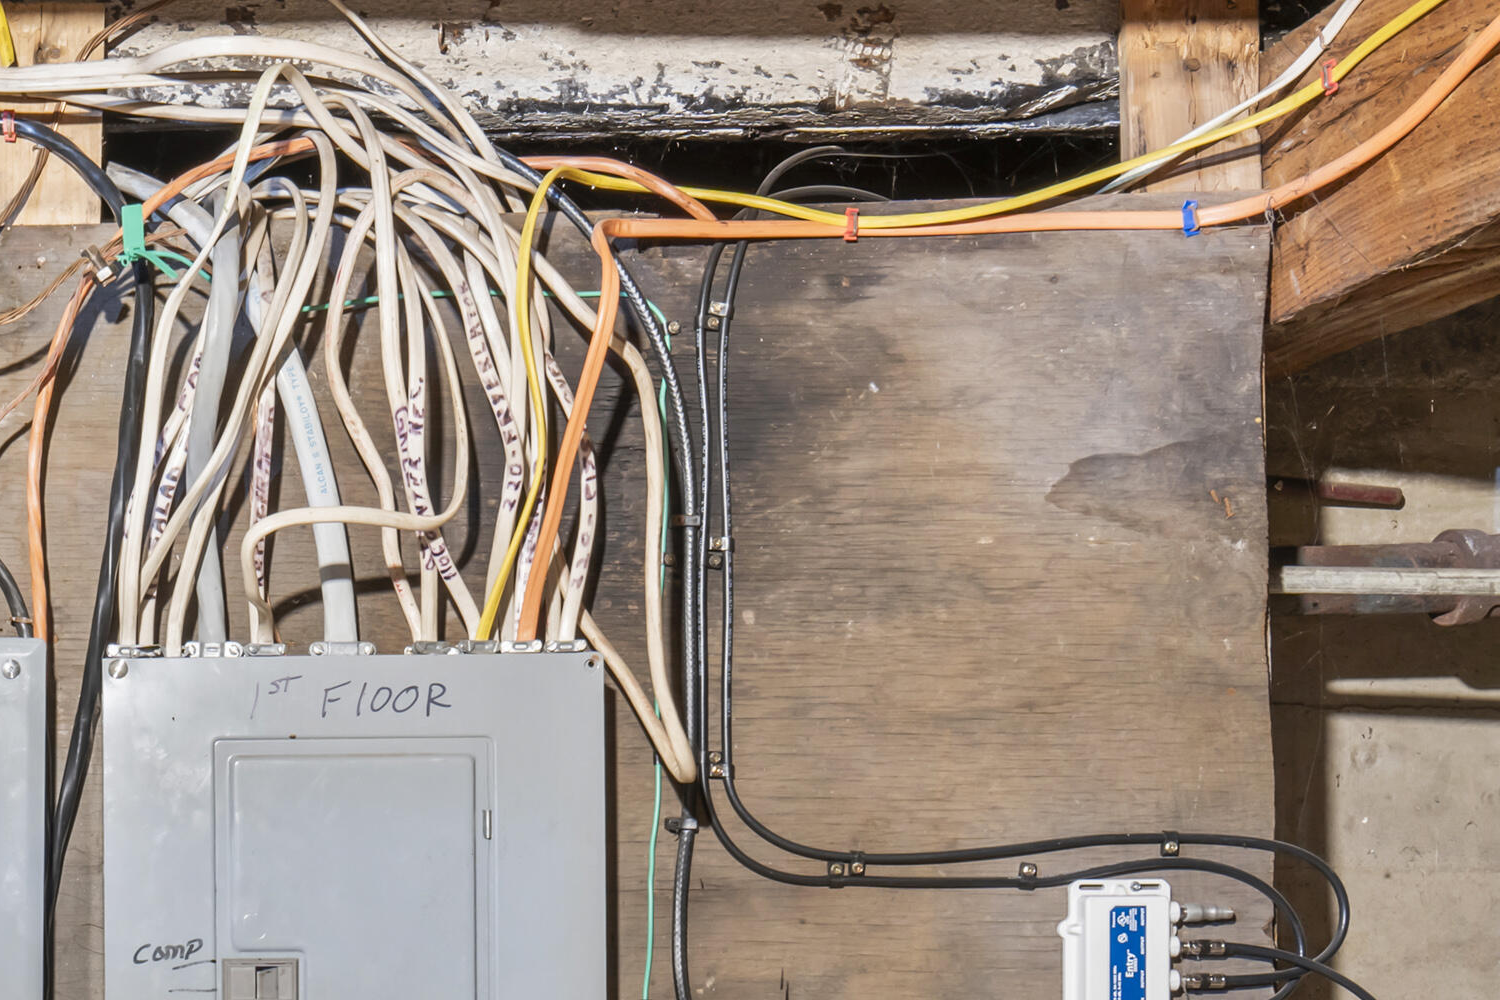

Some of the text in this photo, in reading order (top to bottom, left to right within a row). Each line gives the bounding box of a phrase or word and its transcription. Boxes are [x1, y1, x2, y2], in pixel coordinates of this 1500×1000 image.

[286, 365, 302, 391] TYPE
[314, 462, 329, 496] ALCAN
[249, 675, 304, 720] 1ST
[1125, 952, 1136, 978] Entry
